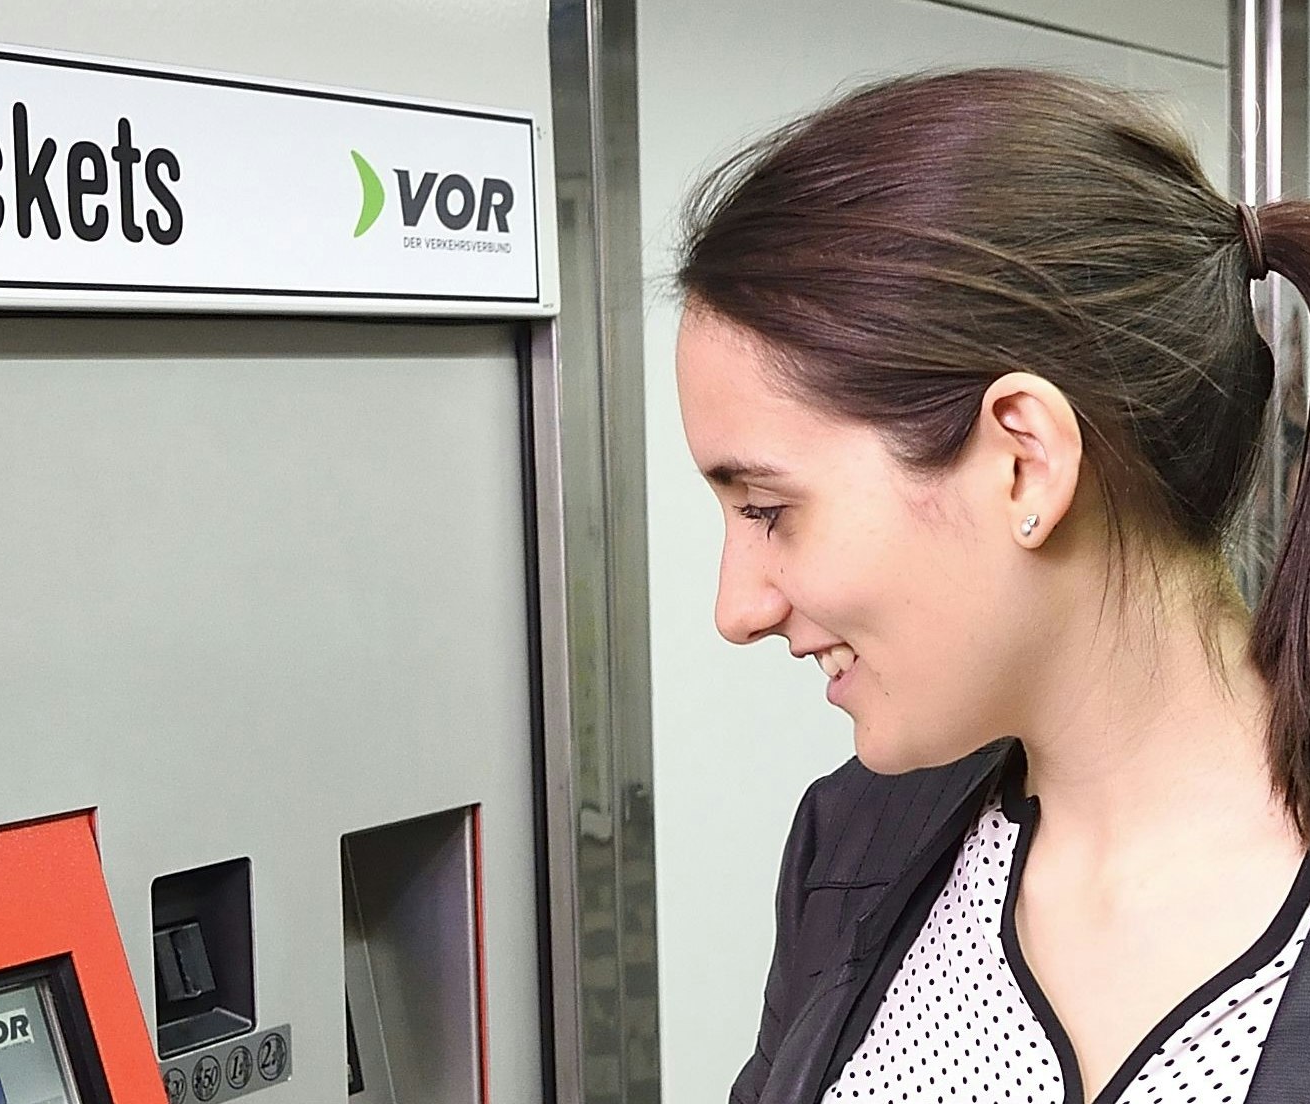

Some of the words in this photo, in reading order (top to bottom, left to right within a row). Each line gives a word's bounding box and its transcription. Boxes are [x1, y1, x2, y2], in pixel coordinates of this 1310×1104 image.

[392, 168, 515, 233] VOR
[403, 237, 422, 249] DER
[425, 238, 512, 253] VERKEHRSVERBUND
